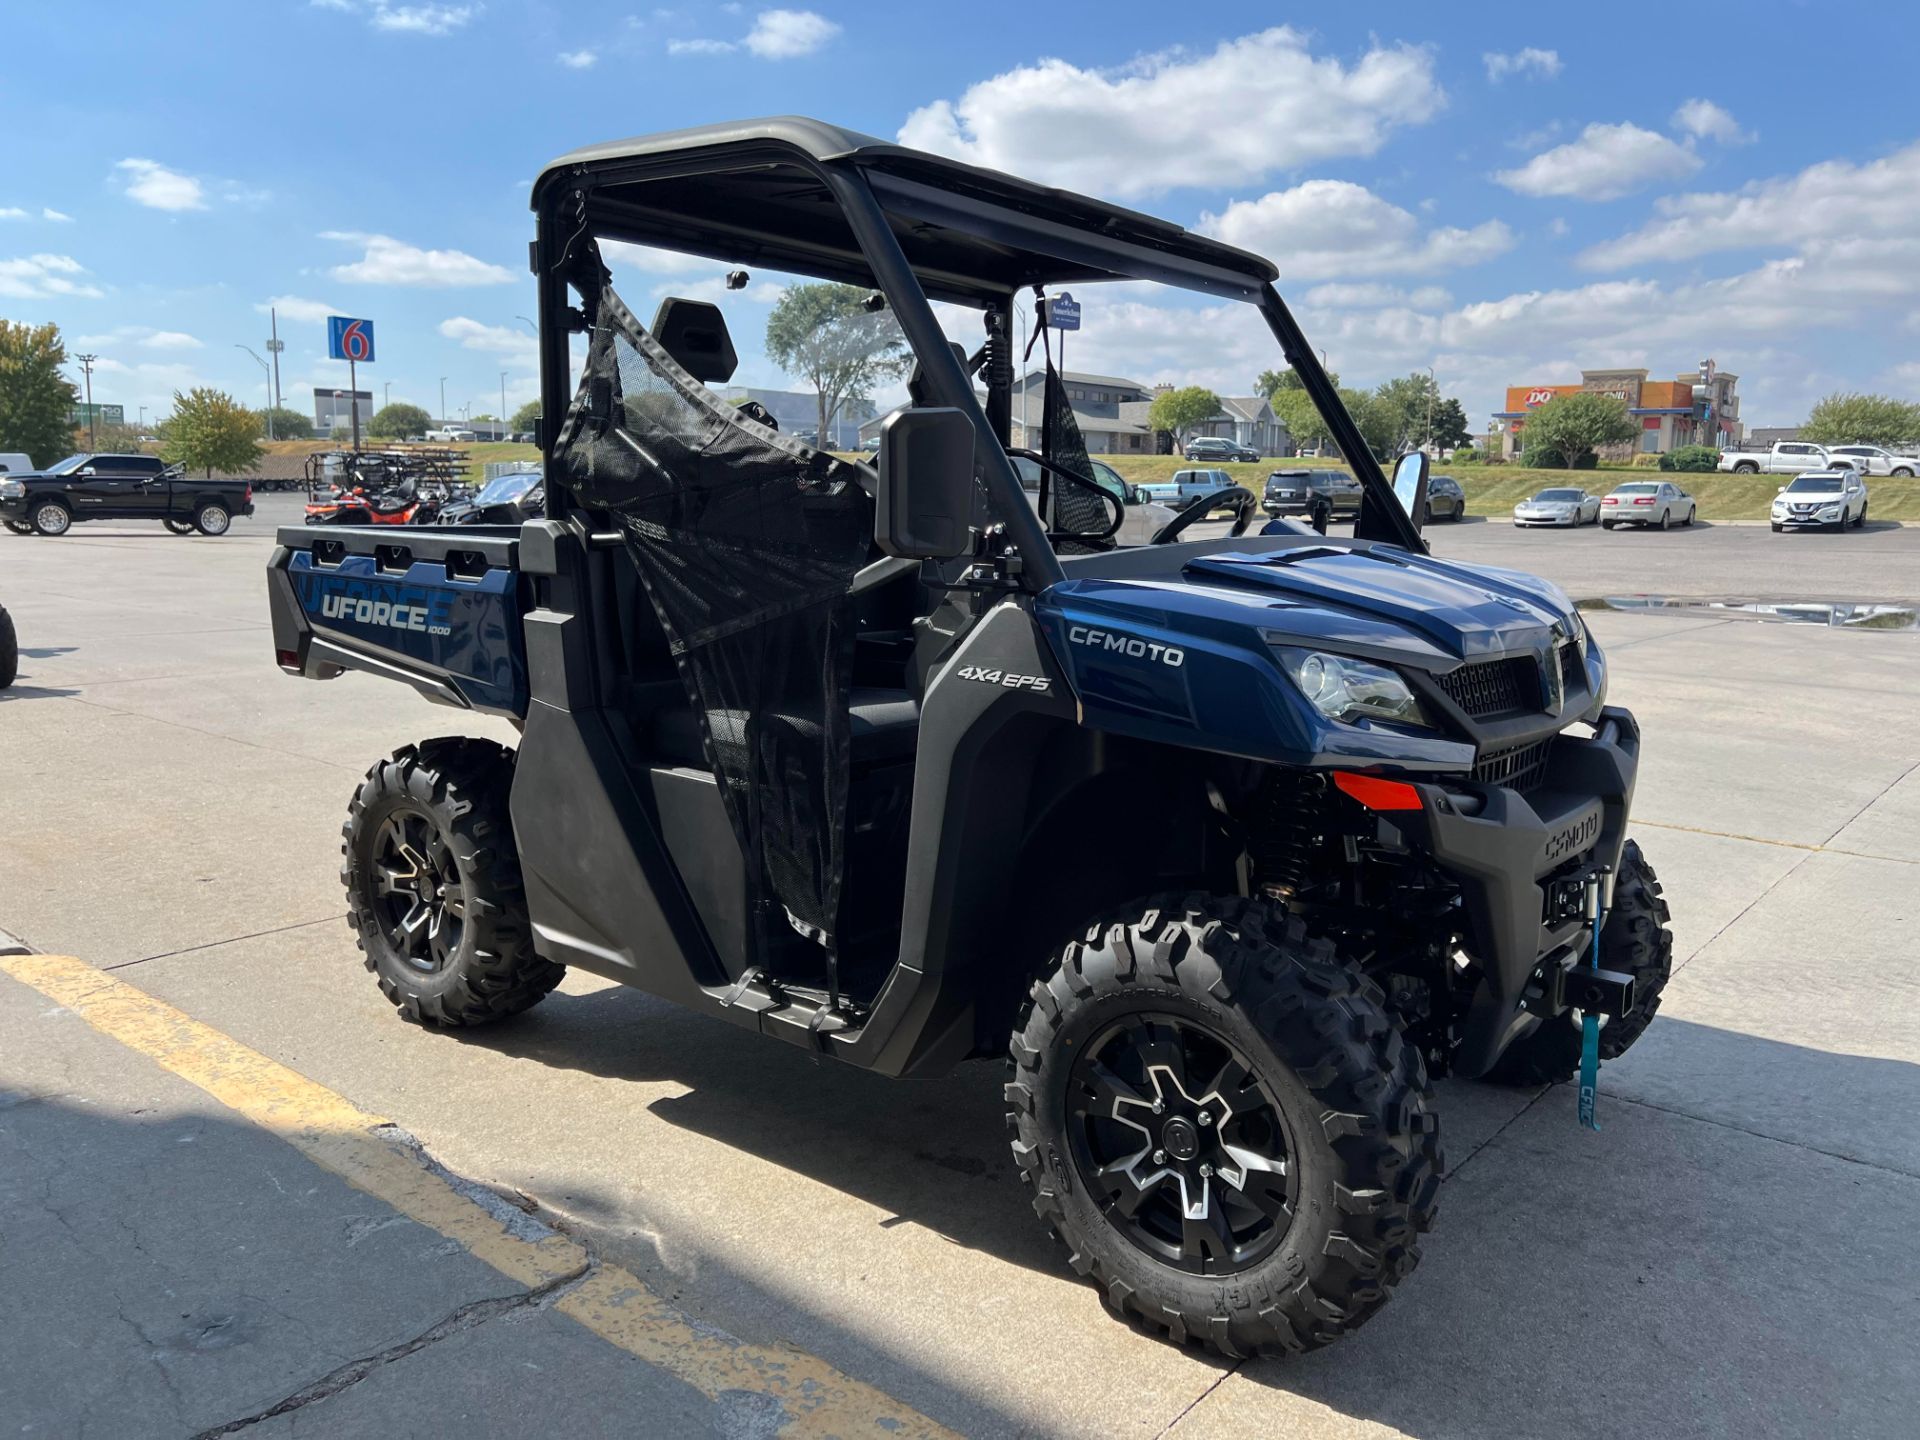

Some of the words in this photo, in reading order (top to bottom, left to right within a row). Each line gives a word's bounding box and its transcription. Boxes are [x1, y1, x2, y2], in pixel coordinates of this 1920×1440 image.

[342, 320, 369, 360] 6
[322, 594, 429, 631] UFORCE
[427, 626, 451, 635] 1000
[1069, 626, 1185, 667] CFMOTO
[1001, 673, 1053, 691] EPS
[1545, 812, 1598, 863] CFMOTO
